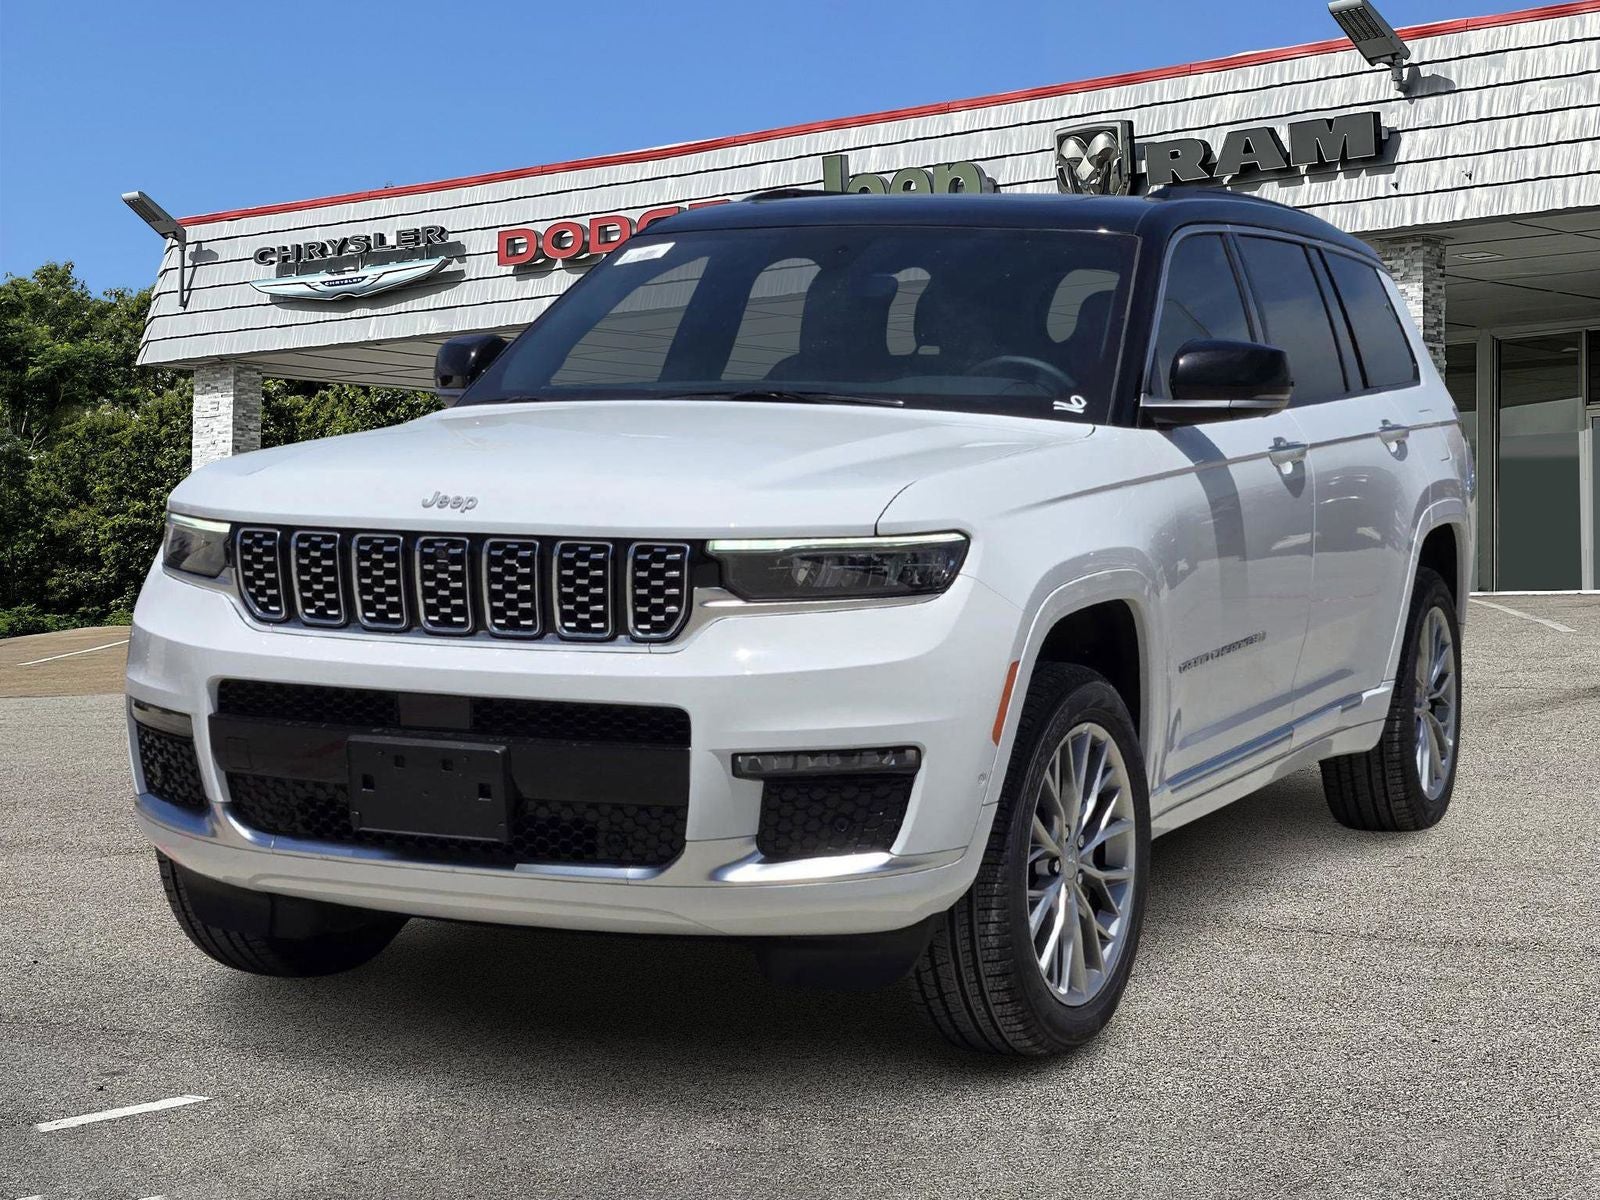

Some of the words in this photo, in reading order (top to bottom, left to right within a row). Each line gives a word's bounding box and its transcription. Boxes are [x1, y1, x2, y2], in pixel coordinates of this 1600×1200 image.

[1144, 111, 1379, 187] RAM
[253, 225, 446, 266] CHRYSLER
[498, 199, 729, 266] DOD
[421, 491, 478, 513] Jeep
